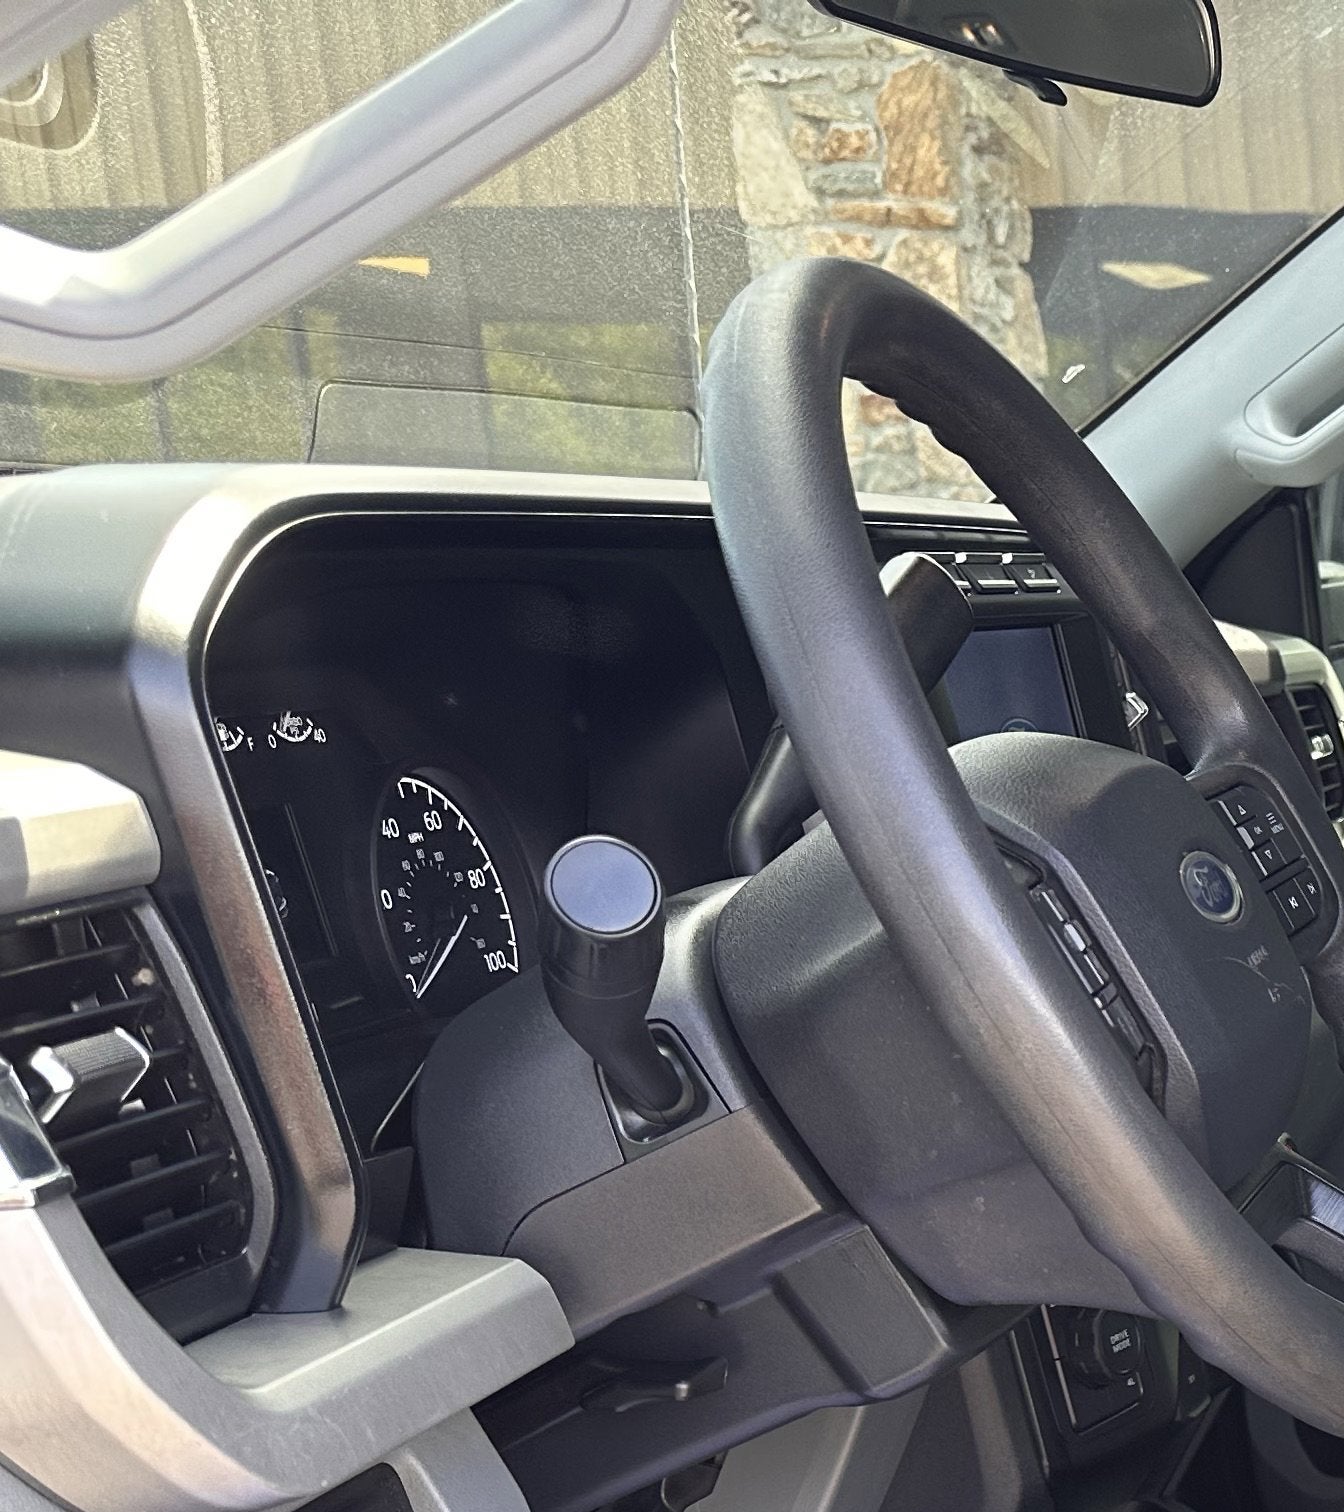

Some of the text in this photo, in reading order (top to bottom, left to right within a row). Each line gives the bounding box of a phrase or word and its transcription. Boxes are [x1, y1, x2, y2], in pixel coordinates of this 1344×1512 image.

[382, 818, 400, 839] 40
[423, 810, 443, 831] 60
[467, 868, 486, 889] 80
[483, 950, 507, 973] 100
